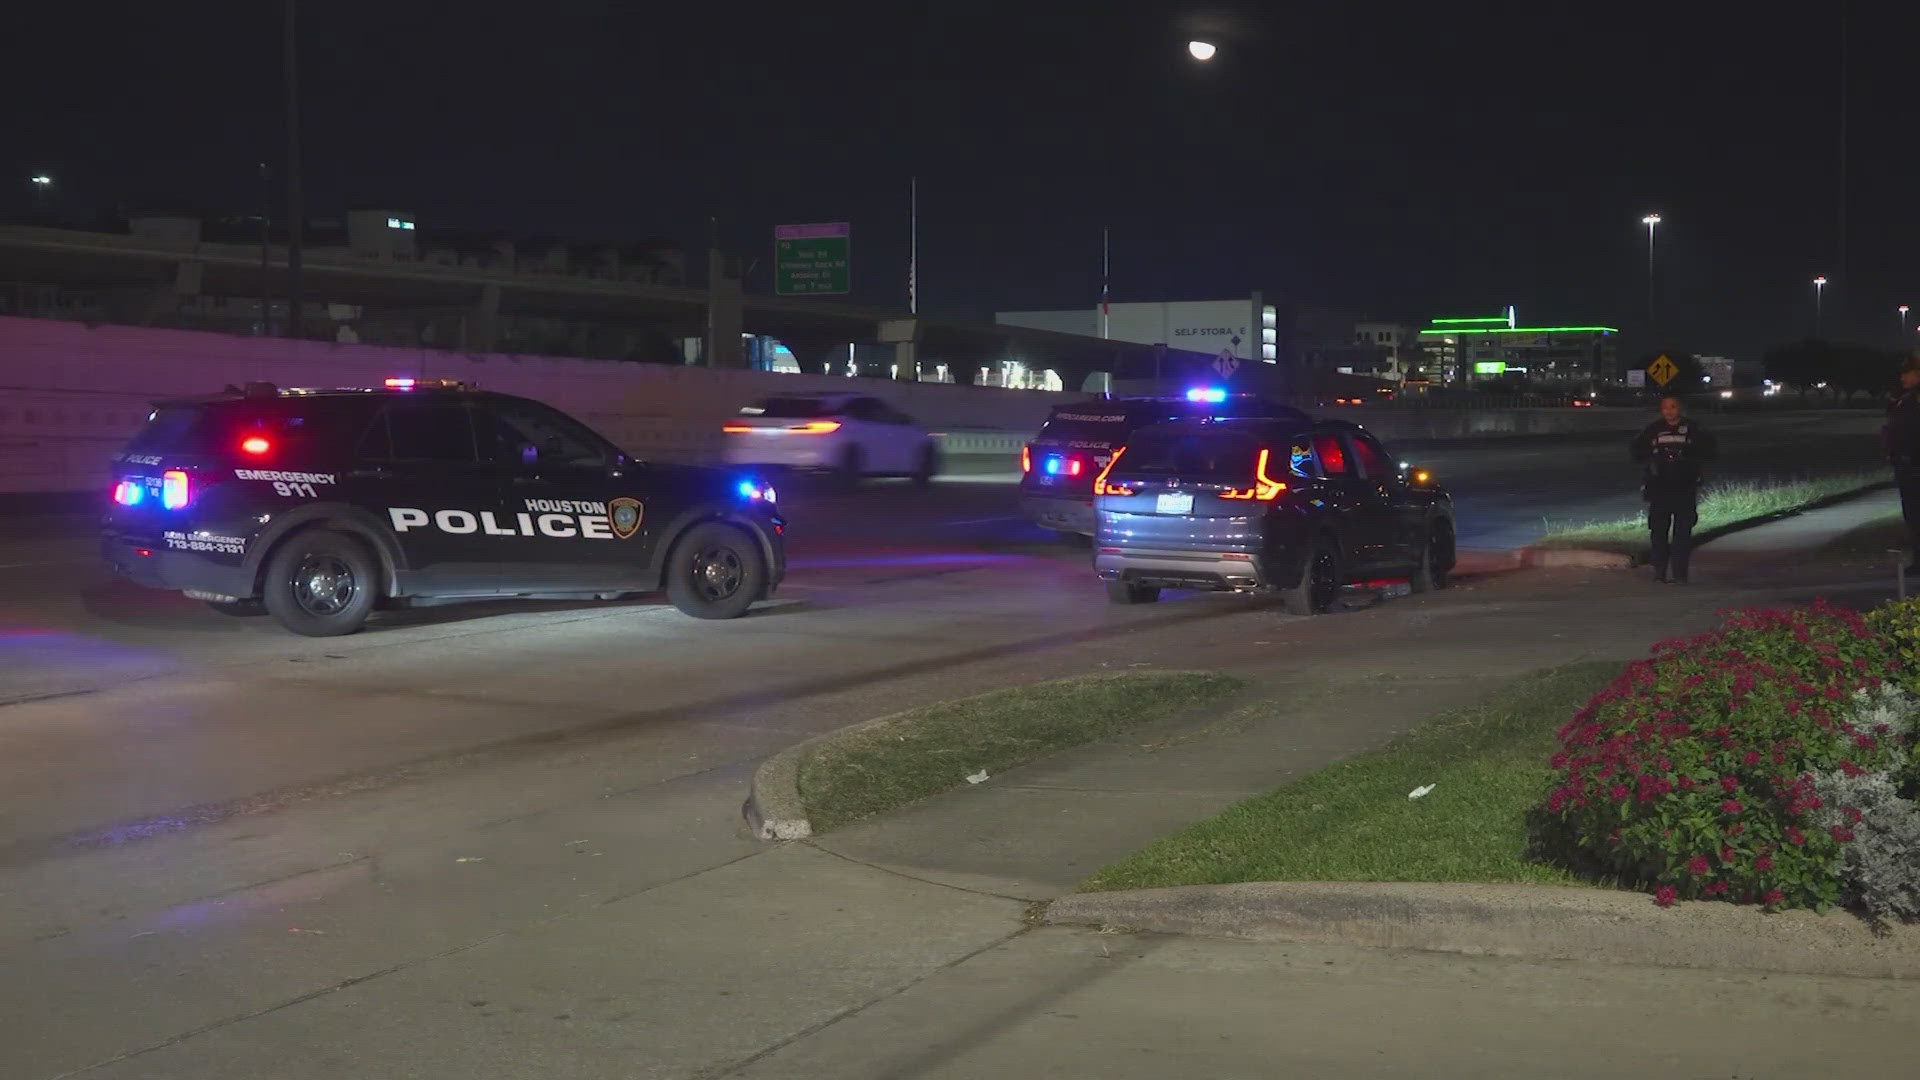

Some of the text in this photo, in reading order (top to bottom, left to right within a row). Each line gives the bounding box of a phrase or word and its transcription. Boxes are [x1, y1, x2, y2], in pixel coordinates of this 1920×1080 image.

[1174, 327, 1246, 337] SELF STORAE
[1067, 440, 1111, 450] POLICE
[125, 454, 162, 466] POLICE
[235, 469, 336, 485] EMERGENCY
[273, 481, 318, 498] 911
[524, 498, 607, 515] HOUSTON
[388, 507, 614, 539] POLICE
[163, 531, 247, 545] NON EMERGENCY
[166, 539, 245, 554] 713-884-3131
